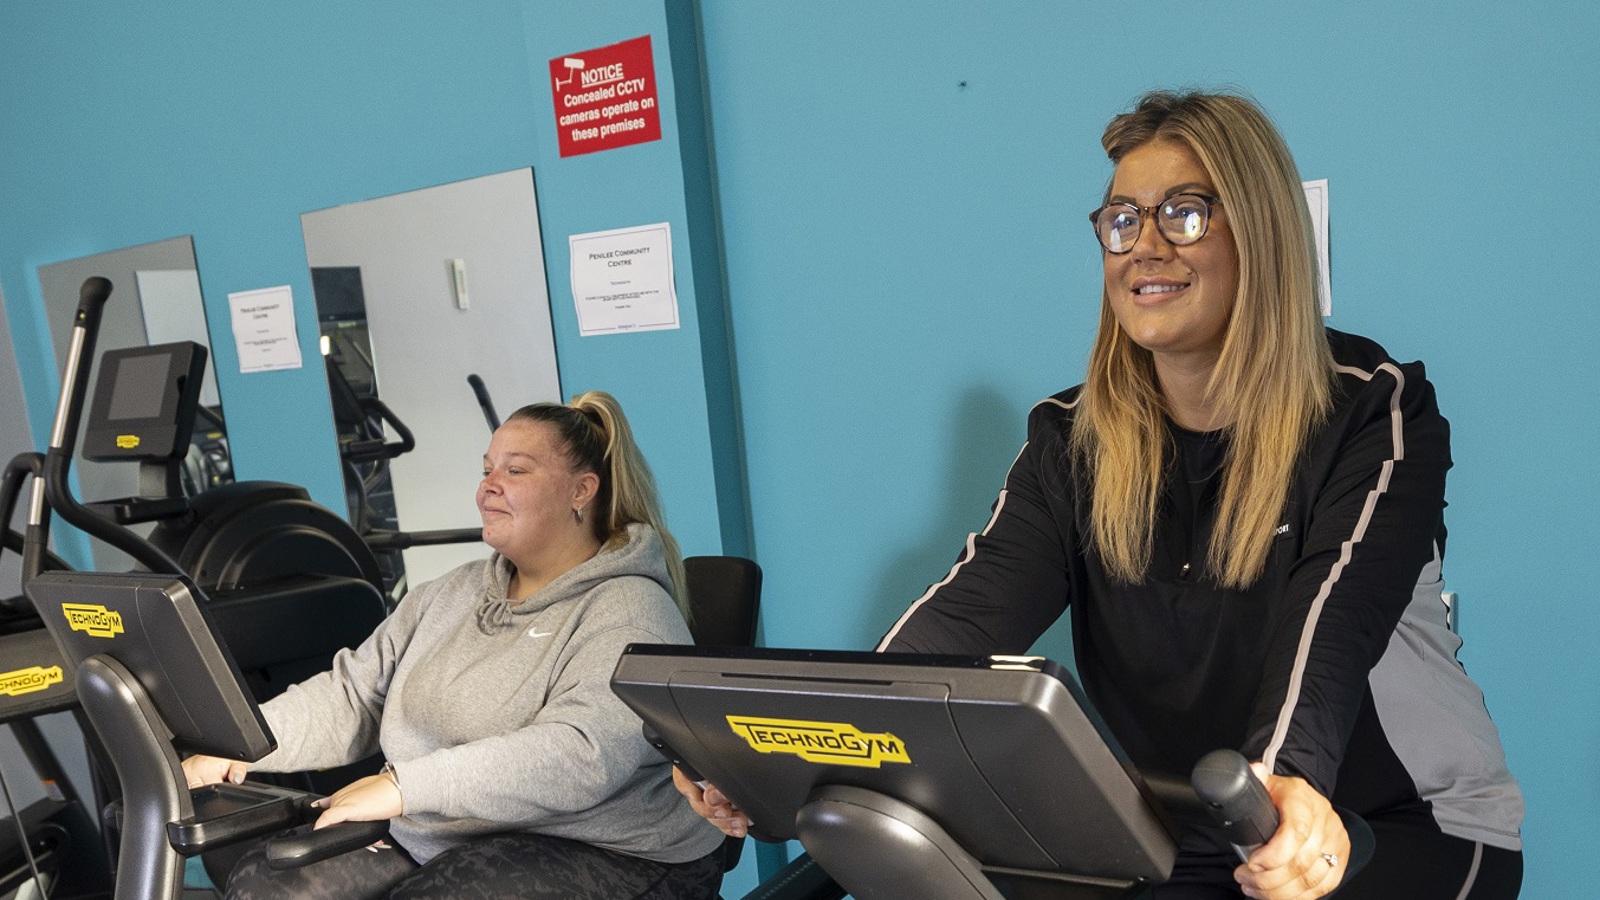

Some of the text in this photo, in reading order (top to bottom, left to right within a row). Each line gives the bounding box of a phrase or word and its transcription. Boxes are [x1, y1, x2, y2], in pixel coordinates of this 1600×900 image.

[581, 63, 623, 85] NOTICE
[564, 78, 645, 107] Concealed CCTV
[560, 97, 654, 126] cameras operate on
[571, 117, 645, 142] these premises
[608, 259, 632, 267] CENTRE
[614, 247, 650, 257] COMMUNITY
[65, 607, 120, 631] TECHNOGYM
[0, 672, 58, 691] CHNOGYM
[733, 721, 900, 759] TECHNOGYM
